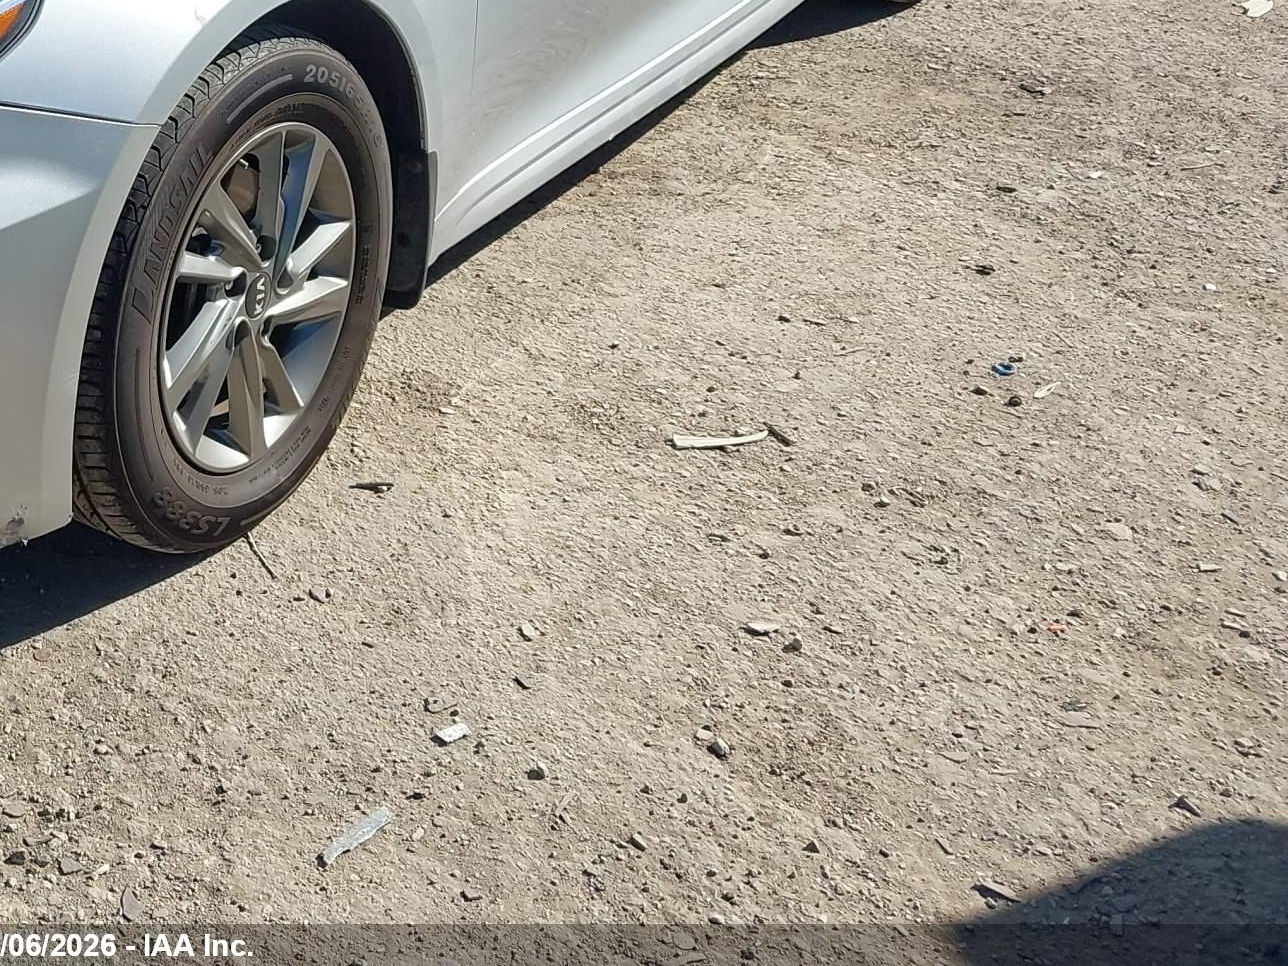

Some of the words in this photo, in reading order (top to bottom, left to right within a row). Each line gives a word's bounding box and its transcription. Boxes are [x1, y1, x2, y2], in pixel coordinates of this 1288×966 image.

[131, 142, 212, 324] LANDSAIL
[253, 275, 266, 315] KIA
[152, 487, 231, 536] LS388
